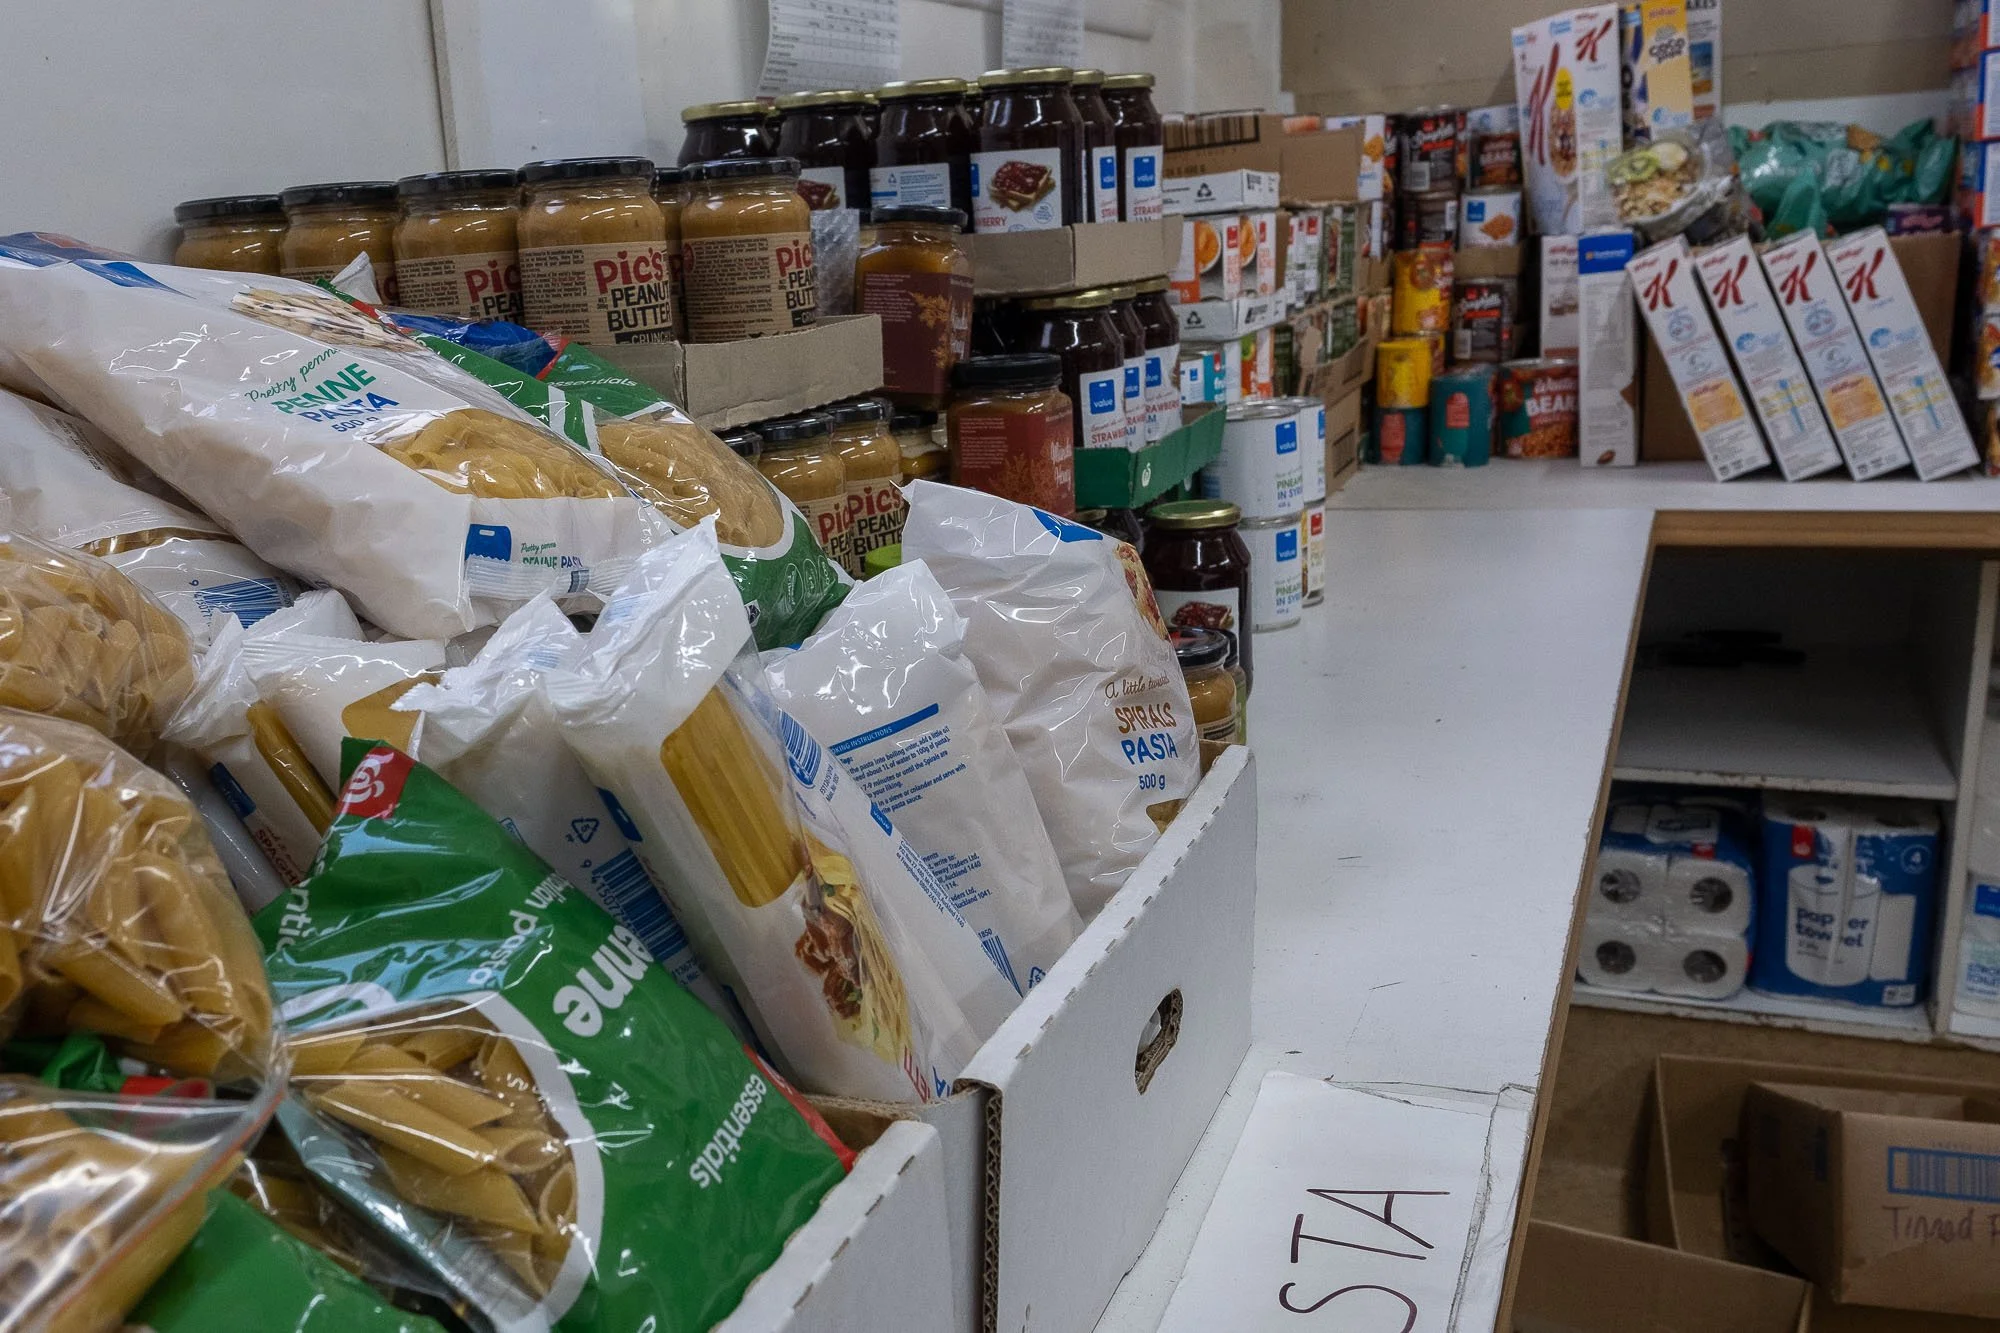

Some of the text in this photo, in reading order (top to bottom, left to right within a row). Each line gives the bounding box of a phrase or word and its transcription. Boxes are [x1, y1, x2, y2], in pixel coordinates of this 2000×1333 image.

[593, 247, 664, 295] Pic's
[611, 280, 669, 309] PEANUT
[607, 301, 672, 333] BUTTER
[244, 376, 297, 402] Pretty
[271, 362, 377, 414] PENNE
[297, 392, 400, 422] PASTA
[1093, 399, 1113, 408] value
[331, 416, 365, 433] 500
[1277, 489, 1287, 500] IN
[1104, 681, 1119, 700] A
[1122, 676, 1147, 696] little
[1115, 701, 1178, 734] SPIRALS
[850, 726, 893, 747] INSTRUCTIONS
[860, 761, 874, 773] pasta
[874, 757, 886, 766] into
[885, 748, 906, 762] boiling
[919, 736, 929, 745] add
[1121, 733, 1179, 765] PASTA
[866, 767, 883, 778] about
[896, 755, 911, 767] water
[917, 748, 930, 759] 100g
[873, 775, 896, 787] minutes
[902, 765, 915, 776] until
[915, 762, 924, 770] the
[873, 788, 886, 799] your
[910, 780, 933, 794] colander
[1139, 773, 1166, 790] 500 g
[891, 801, 906, 813] pasta
[580, 859, 592, 868] 9
[934, 858, 948, 867] write
[945, 860, 981, 882] Auckland 1440
[949, 857, 968, 870] Traders
[968, 852, 980, 862] Ltd,
[966, 887, 977, 896] Ltd,
[978, 928, 993, 939] 1850
[468, 910, 537, 986] pasta
[688, 1072, 767, 1188] essentials
[1278, 1188, 1451, 1333] STA
